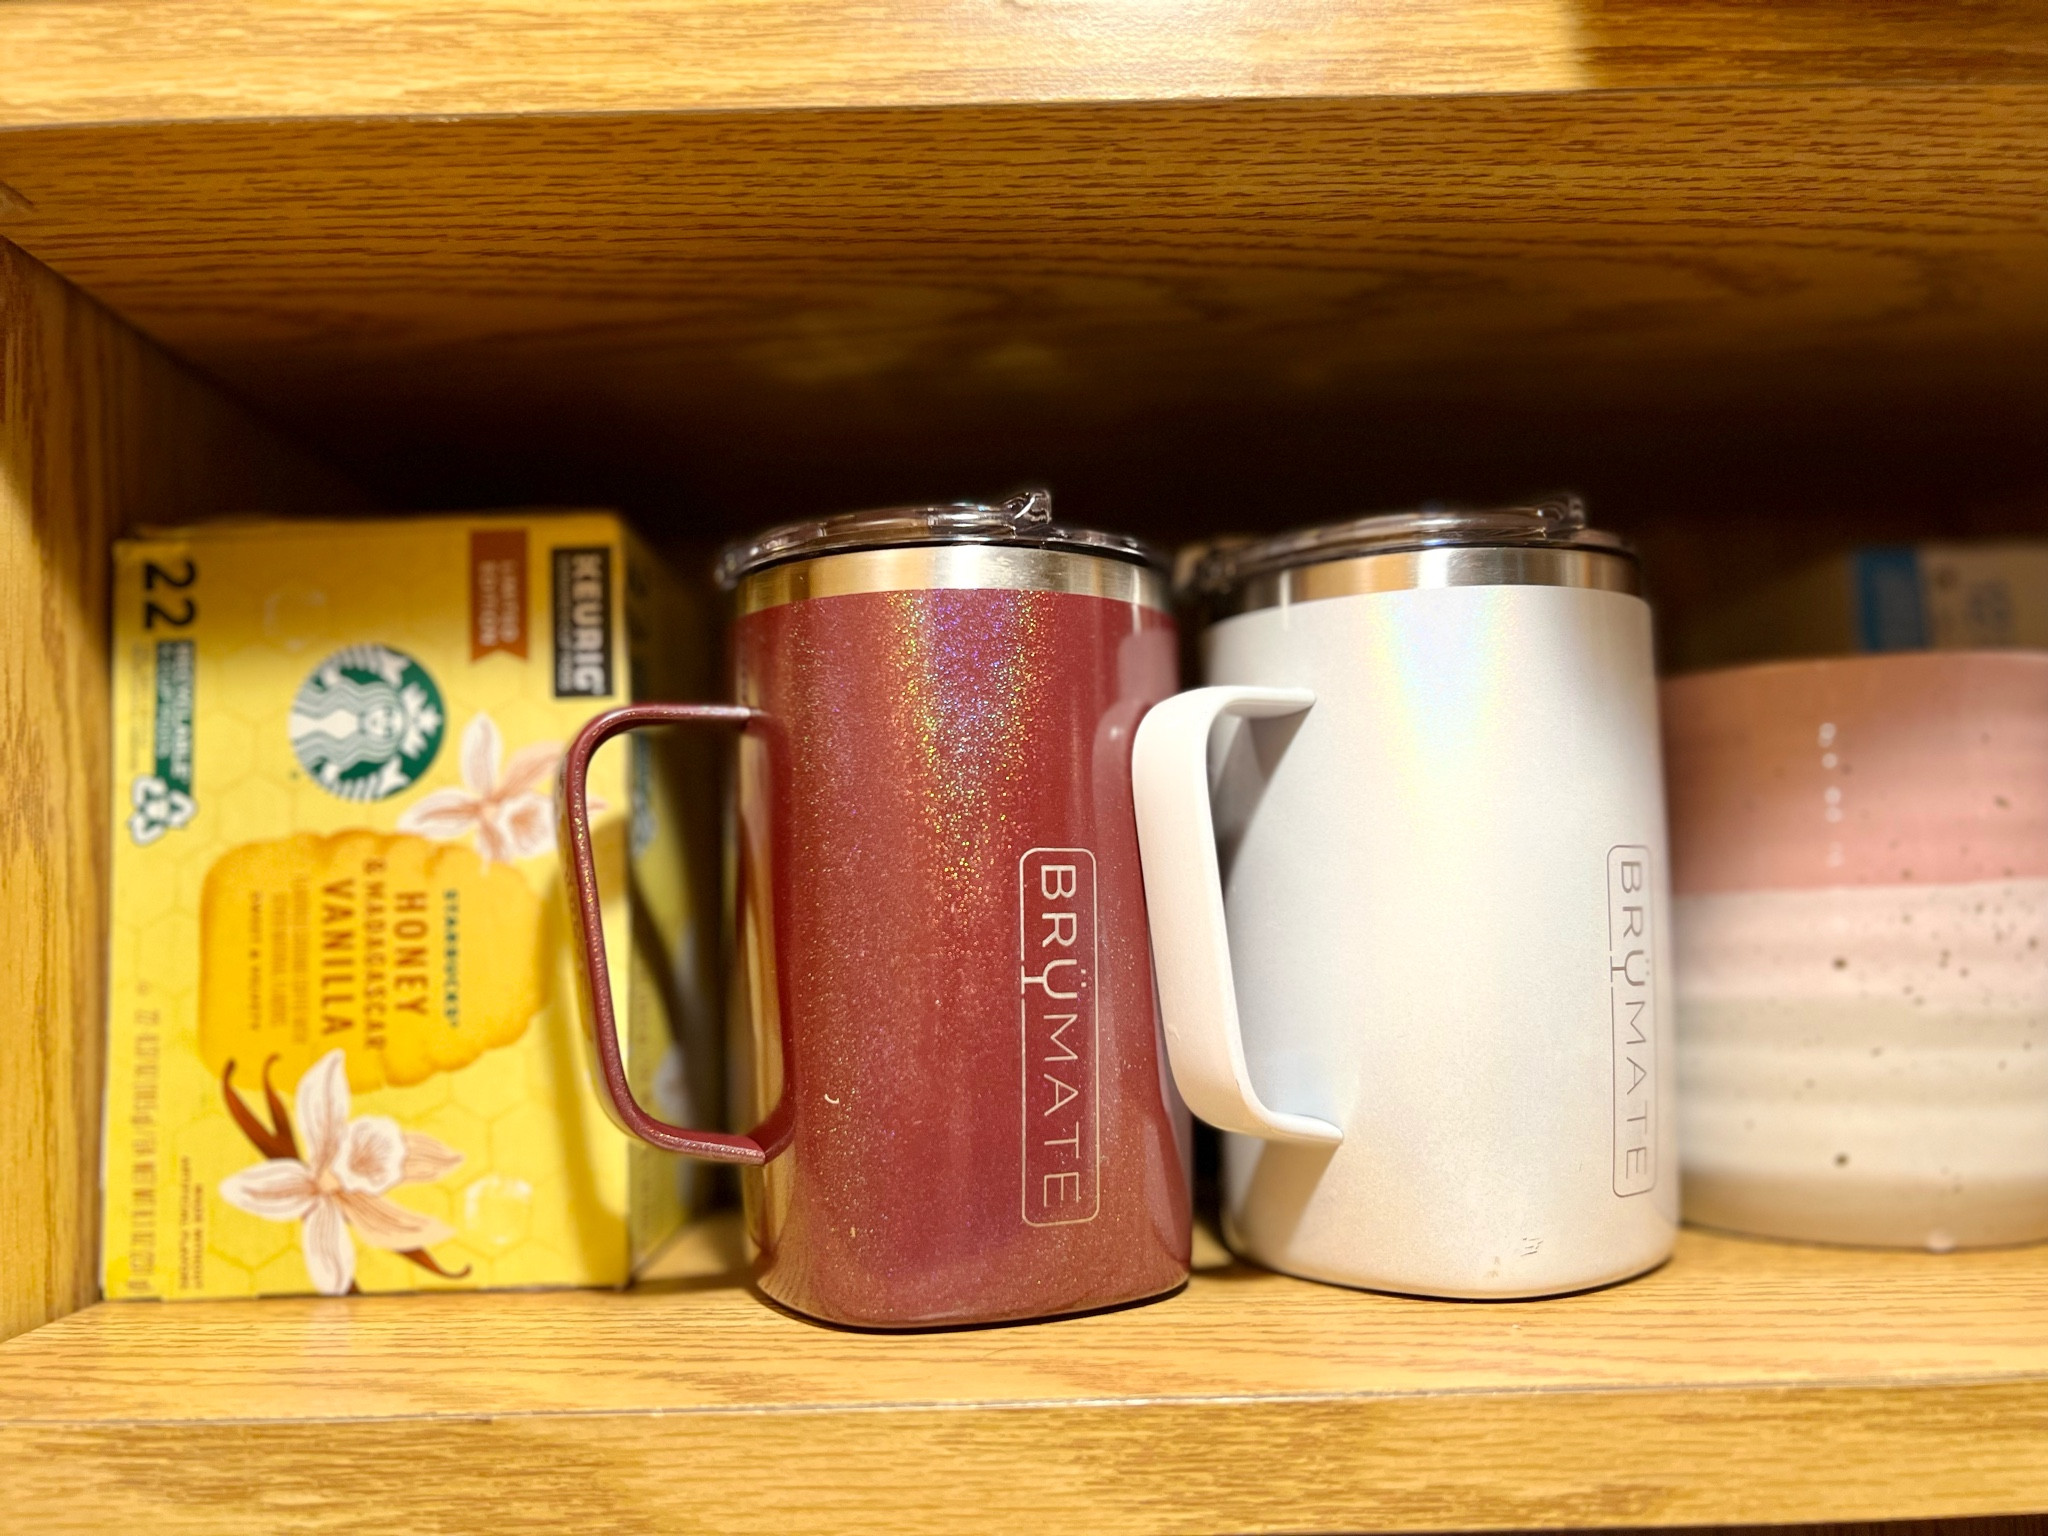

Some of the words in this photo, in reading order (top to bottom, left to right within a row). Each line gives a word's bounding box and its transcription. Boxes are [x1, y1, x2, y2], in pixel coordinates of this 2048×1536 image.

[145, 561, 196, 629] 22
[571, 553, 606, 692] KEURIG
[321, 878, 355, 1036] VANILLA
[364, 880, 387, 1052] MADAGASCAR
[394, 891, 429, 1016] HONEY
[1610, 860, 1651, 1180] BRÜMATE
[1021, 864, 1088, 1208] BRÜMATE
